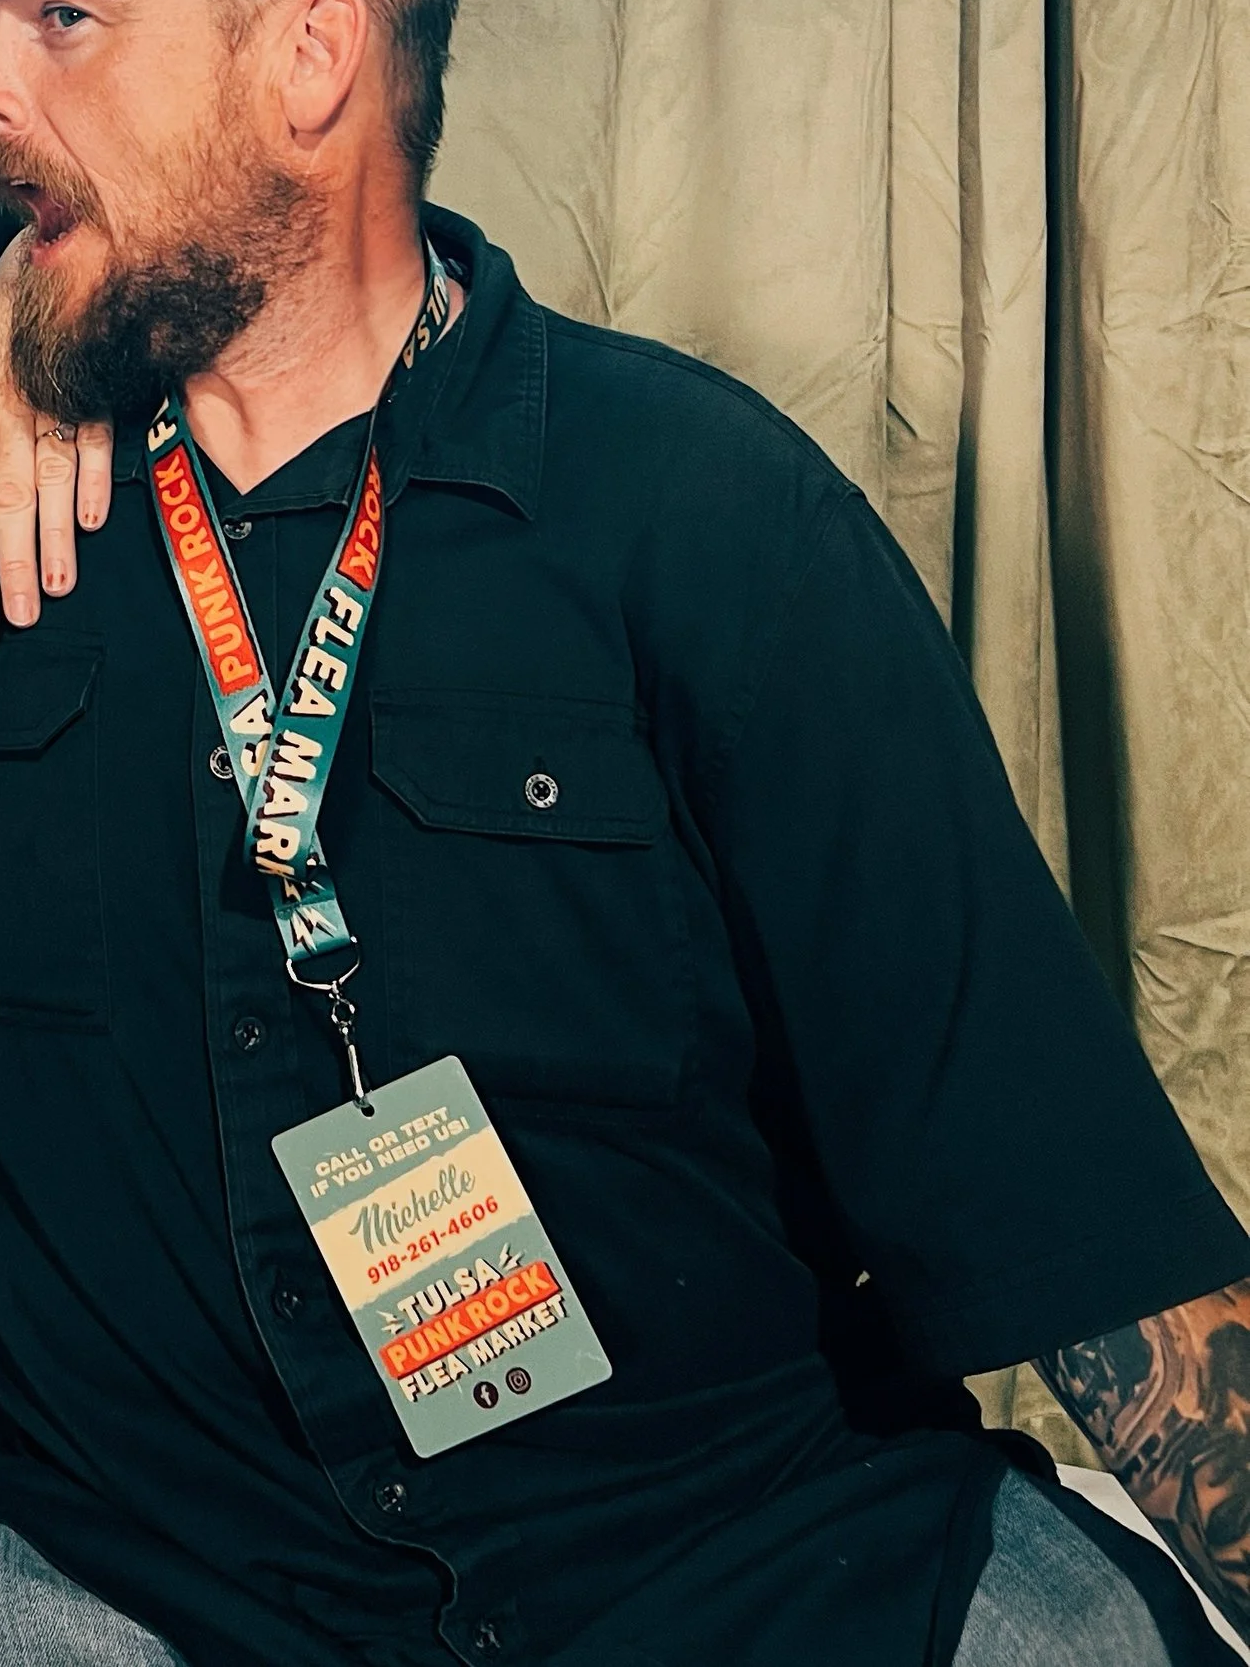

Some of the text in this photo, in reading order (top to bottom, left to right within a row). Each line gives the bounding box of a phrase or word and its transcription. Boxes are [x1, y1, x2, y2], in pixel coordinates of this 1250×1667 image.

[155, 454, 213, 562] ROCK
[187, 558, 254, 684] PUNK
[289, 586, 363, 716] FLEA
[310, 1116, 470, 1199] IF YOU NEED US!
[315, 1106, 448, 1177] CALL OR TEXT
[348, 1163, 476, 1255] Michelle
[367, 1195, 499, 1285] 918-261-4606
[387, 1264, 550, 1372] PUNK ROCK
[397, 1258, 503, 1326] TULSA
[399, 1294, 568, 1402] FLEA MARKET
